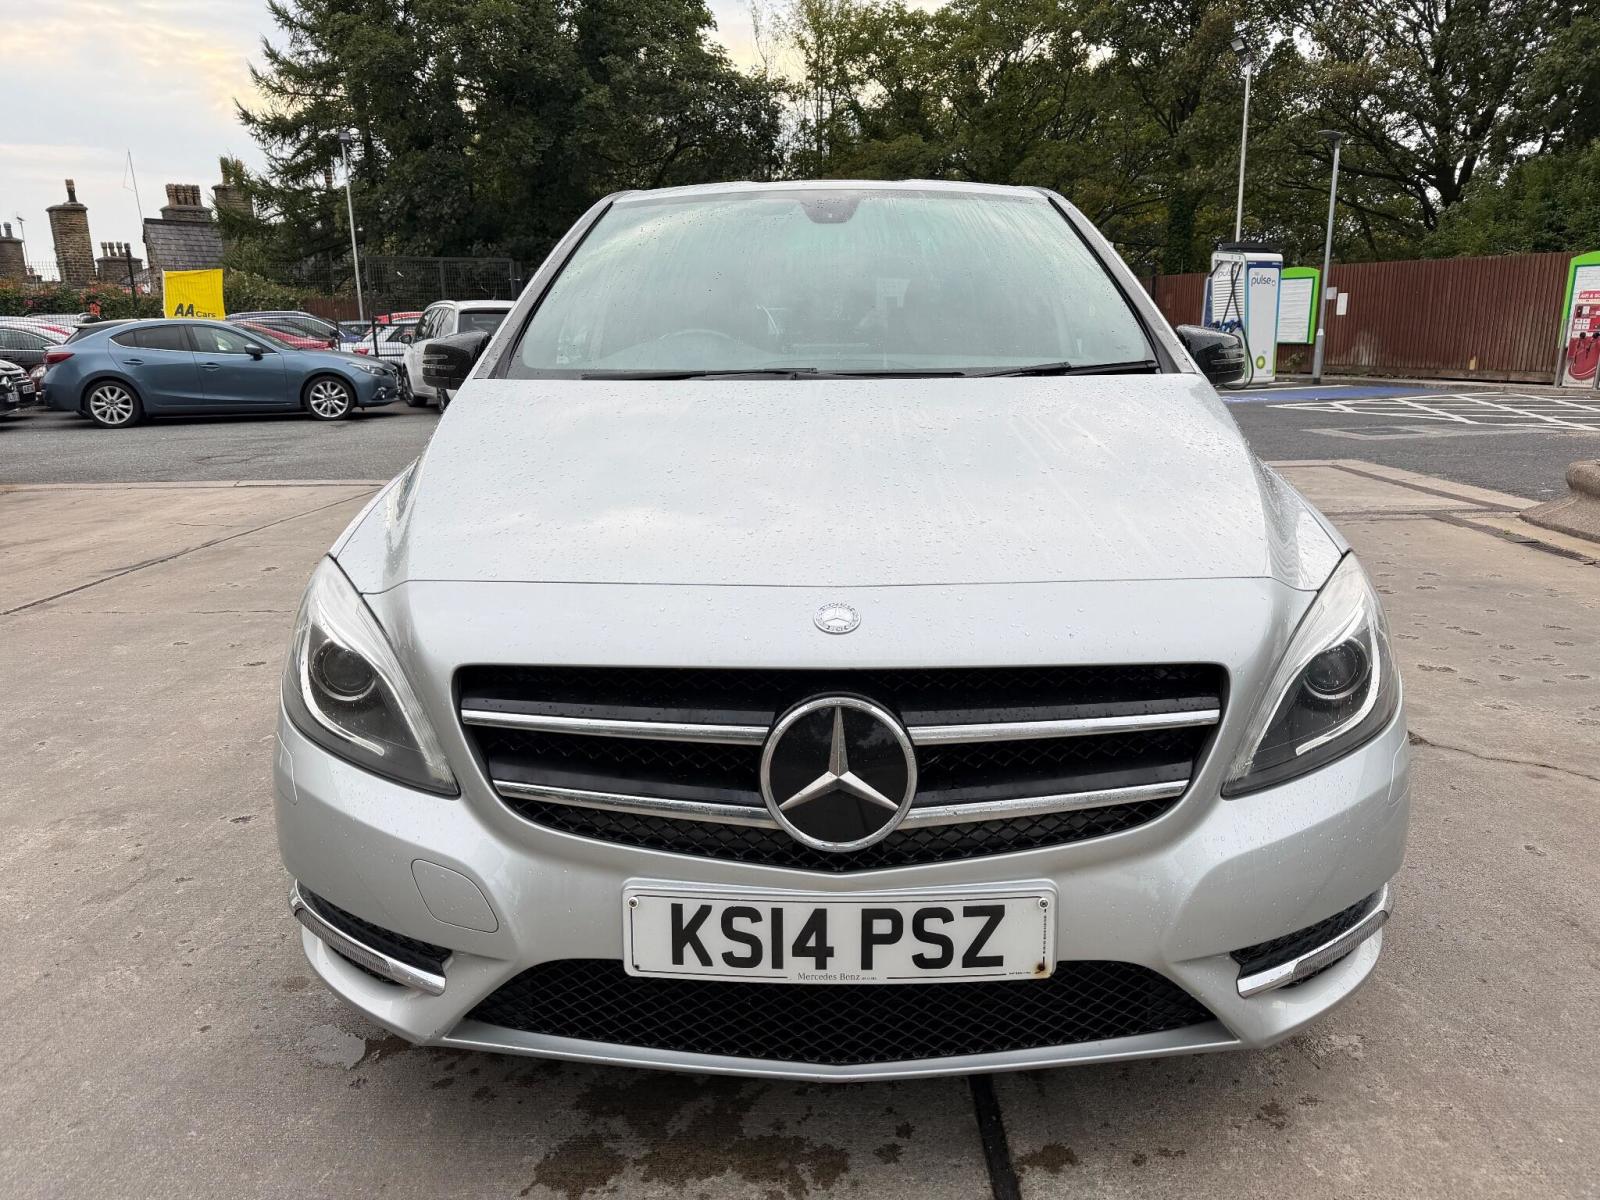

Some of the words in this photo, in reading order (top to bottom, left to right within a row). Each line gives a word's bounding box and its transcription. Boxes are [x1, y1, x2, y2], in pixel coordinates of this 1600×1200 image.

[1250, 274, 1272, 287] pulse
[174, 303, 195, 317] AA
[195, 310, 217, 318] Cars
[671, 903, 834, 970] KS14
[861, 905, 1005, 970] PSZ
[798, 972, 837, 980] Mercedes
